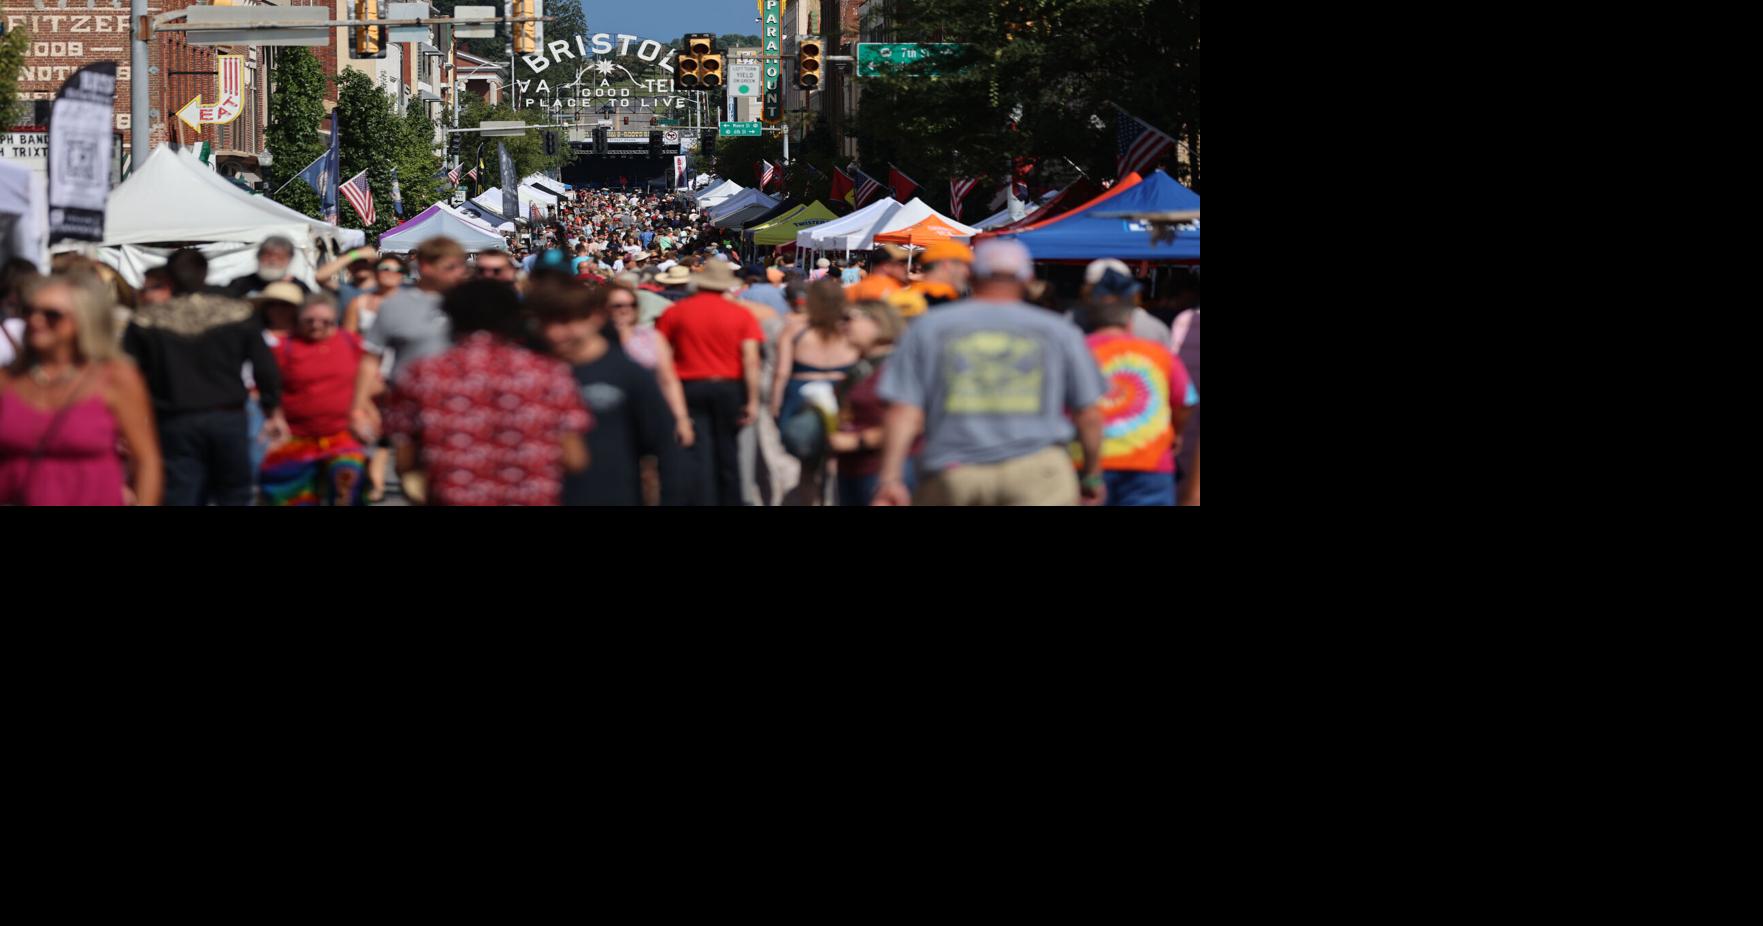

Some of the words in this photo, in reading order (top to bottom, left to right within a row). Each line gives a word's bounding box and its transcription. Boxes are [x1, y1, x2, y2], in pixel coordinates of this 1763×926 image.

[522, 33, 676, 74] BRISTOL
[901, 48, 917, 58] 7th
[516, 79, 551, 93] VA
[600, 78, 610, 87] A
[581, 88, 630, 97] GOOD
[199, 96, 239, 121] EAT
[525, 98, 592, 108] PLACE
[610, 98, 630, 107] TO
[641, 98, 686, 109] LIVE
[12, 146, 49, 157] TRIXT
